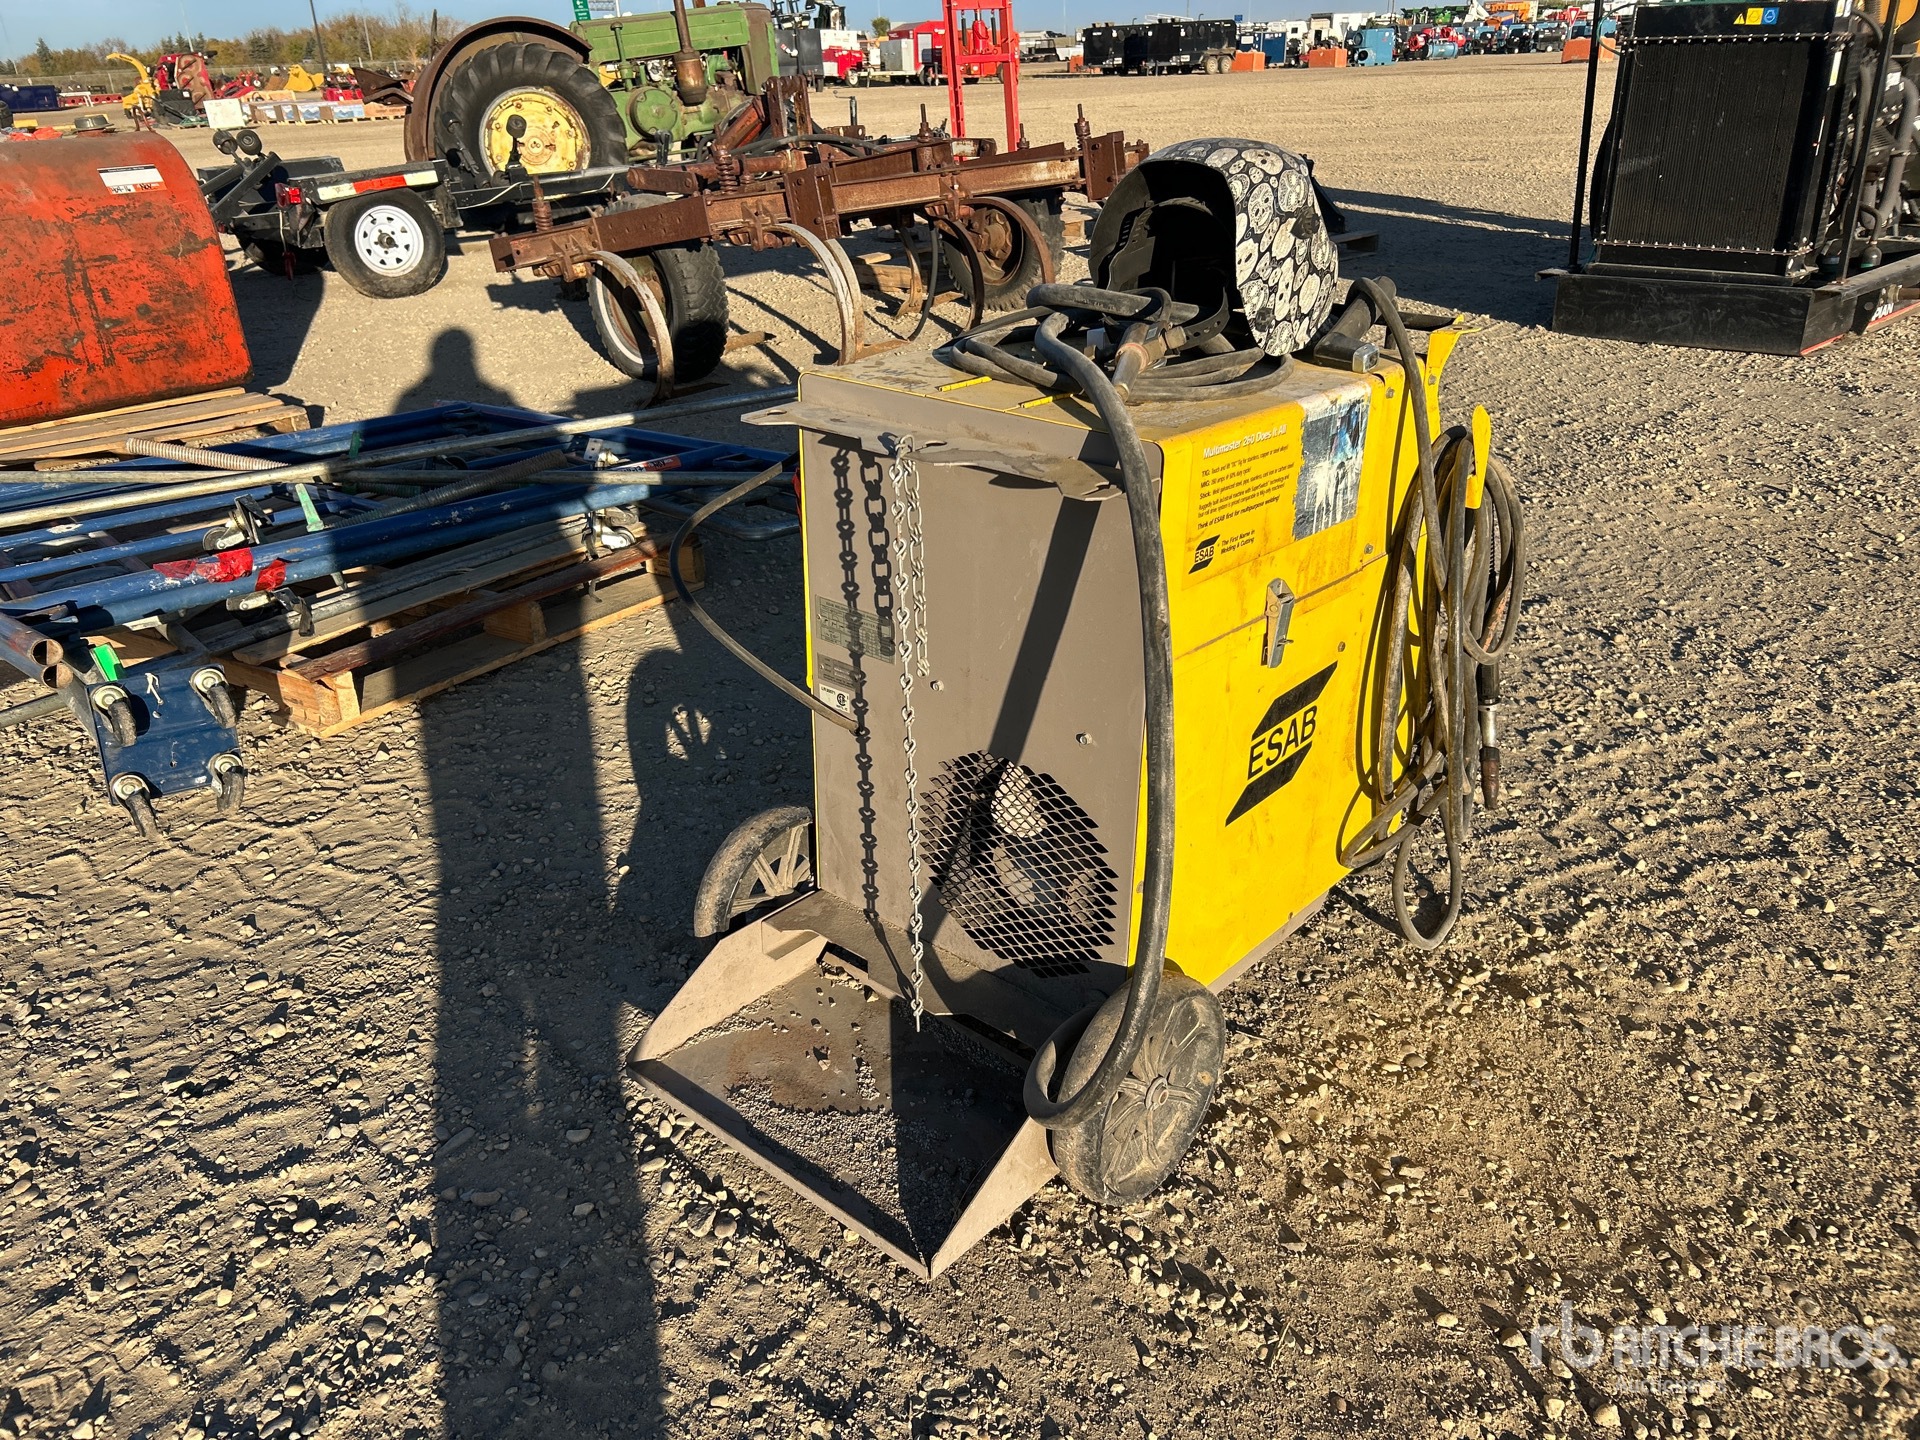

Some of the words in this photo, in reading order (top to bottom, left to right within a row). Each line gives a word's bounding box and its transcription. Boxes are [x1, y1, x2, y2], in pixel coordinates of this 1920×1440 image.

[1203, 440, 1242, 459] Multimaster
[1256, 431, 1272, 442] Does
[1279, 424, 1288, 436] All
[1230, 536, 1239, 544] First
[1194, 546, 1214, 563] ESAB
[1247, 705, 1318, 781] ESAB
